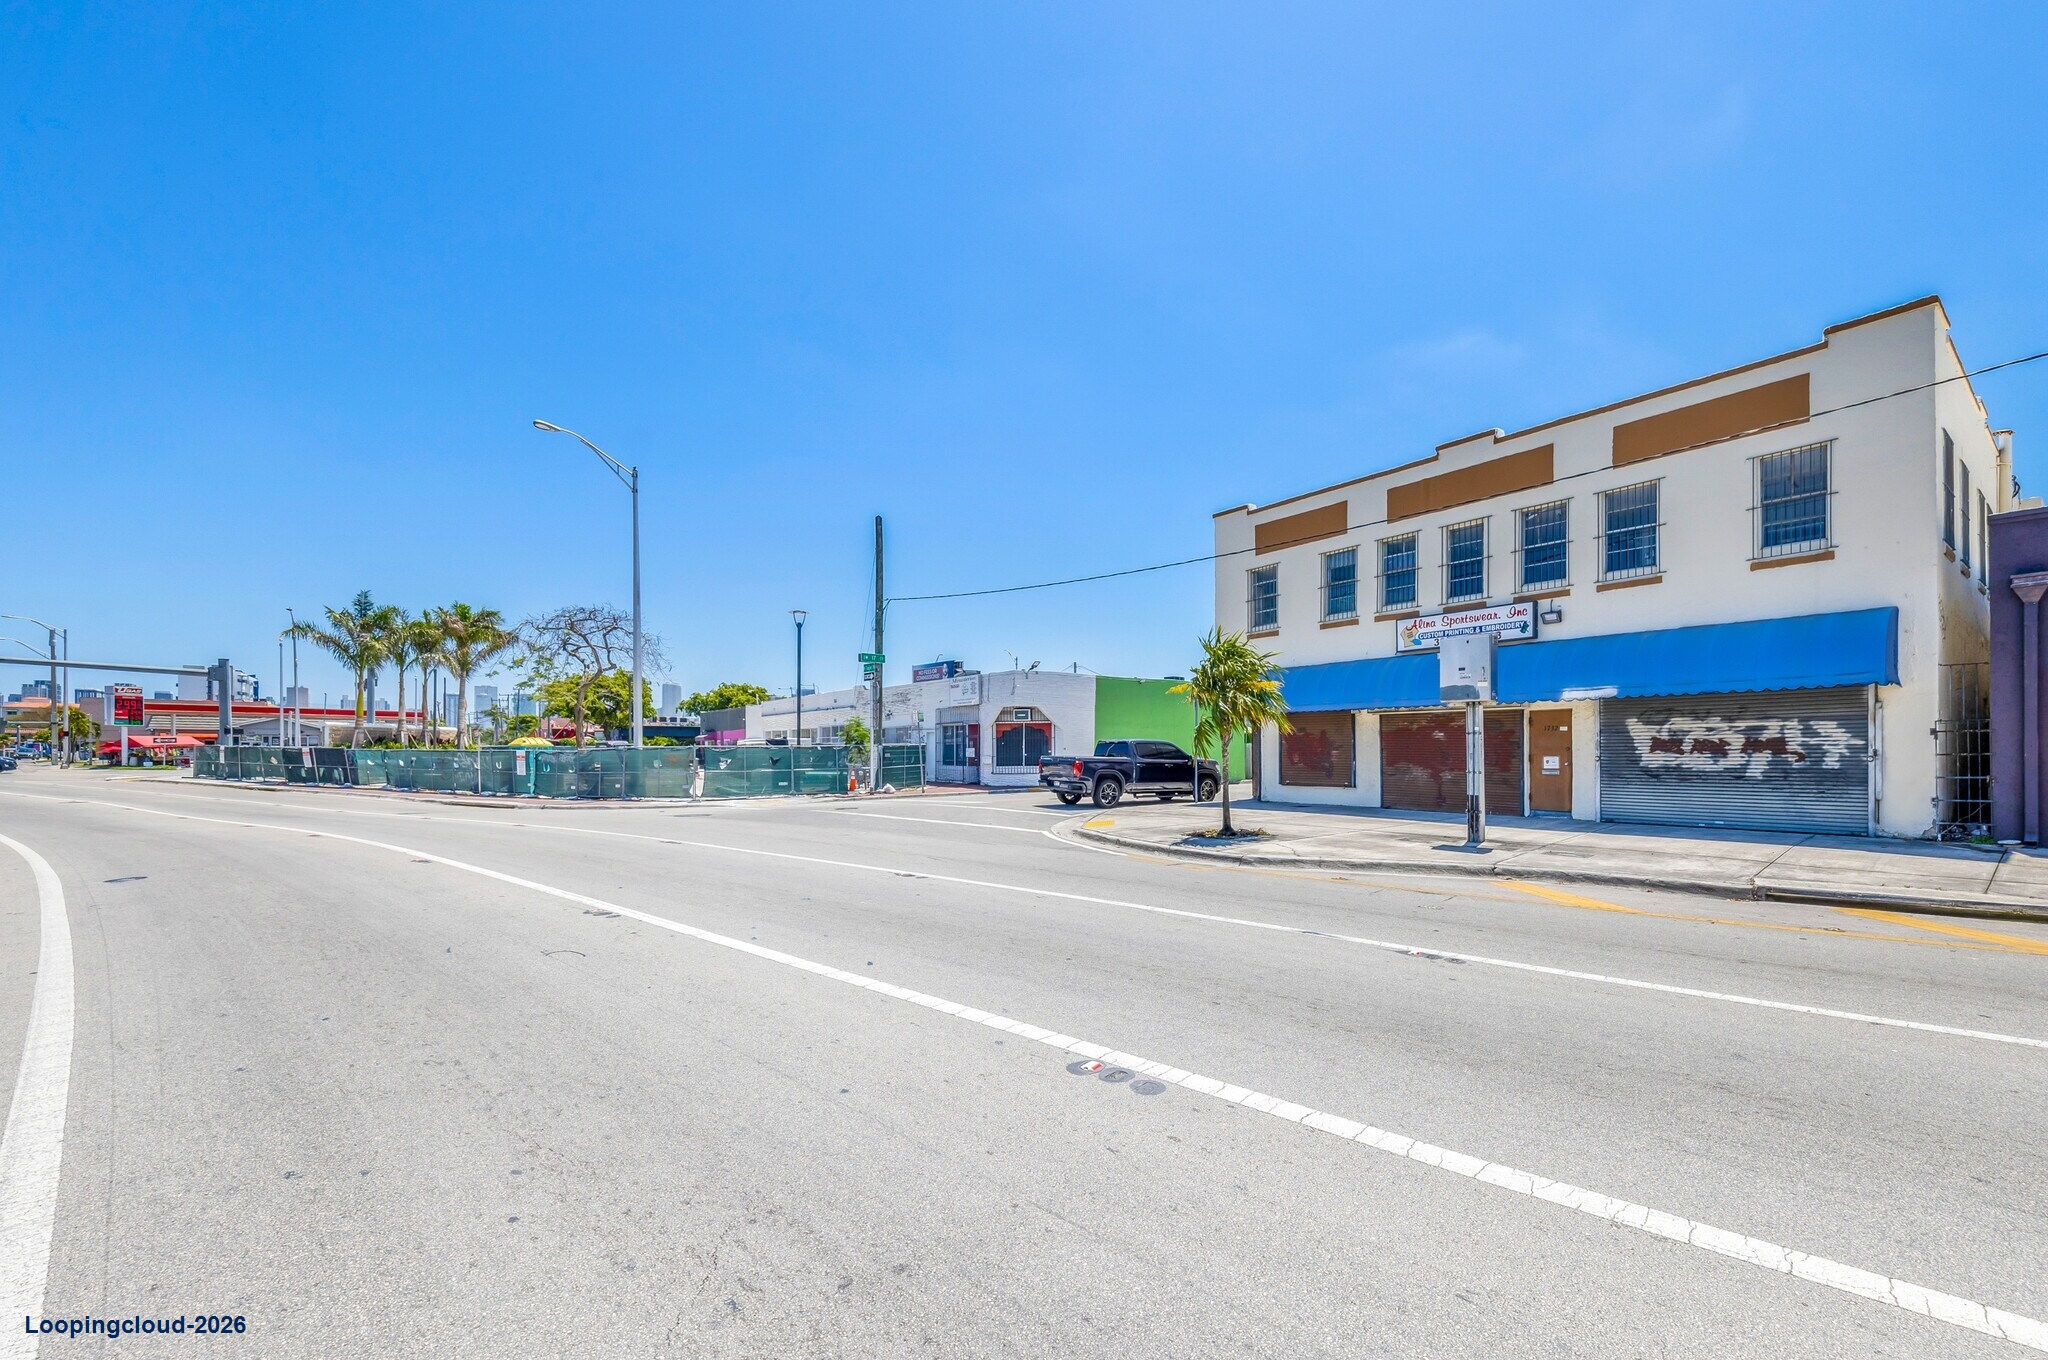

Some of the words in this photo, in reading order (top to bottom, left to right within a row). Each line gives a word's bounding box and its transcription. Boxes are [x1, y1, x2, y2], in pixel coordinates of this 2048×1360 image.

[1406, 619, 1436, 631] Alina
[1507, 606, 1528, 619] Inc
[1420, 630, 1444, 640] CUSTOM
[1445, 627, 1474, 638] PRINTING
[1482, 621, 1524, 632] EMBROIDERY
